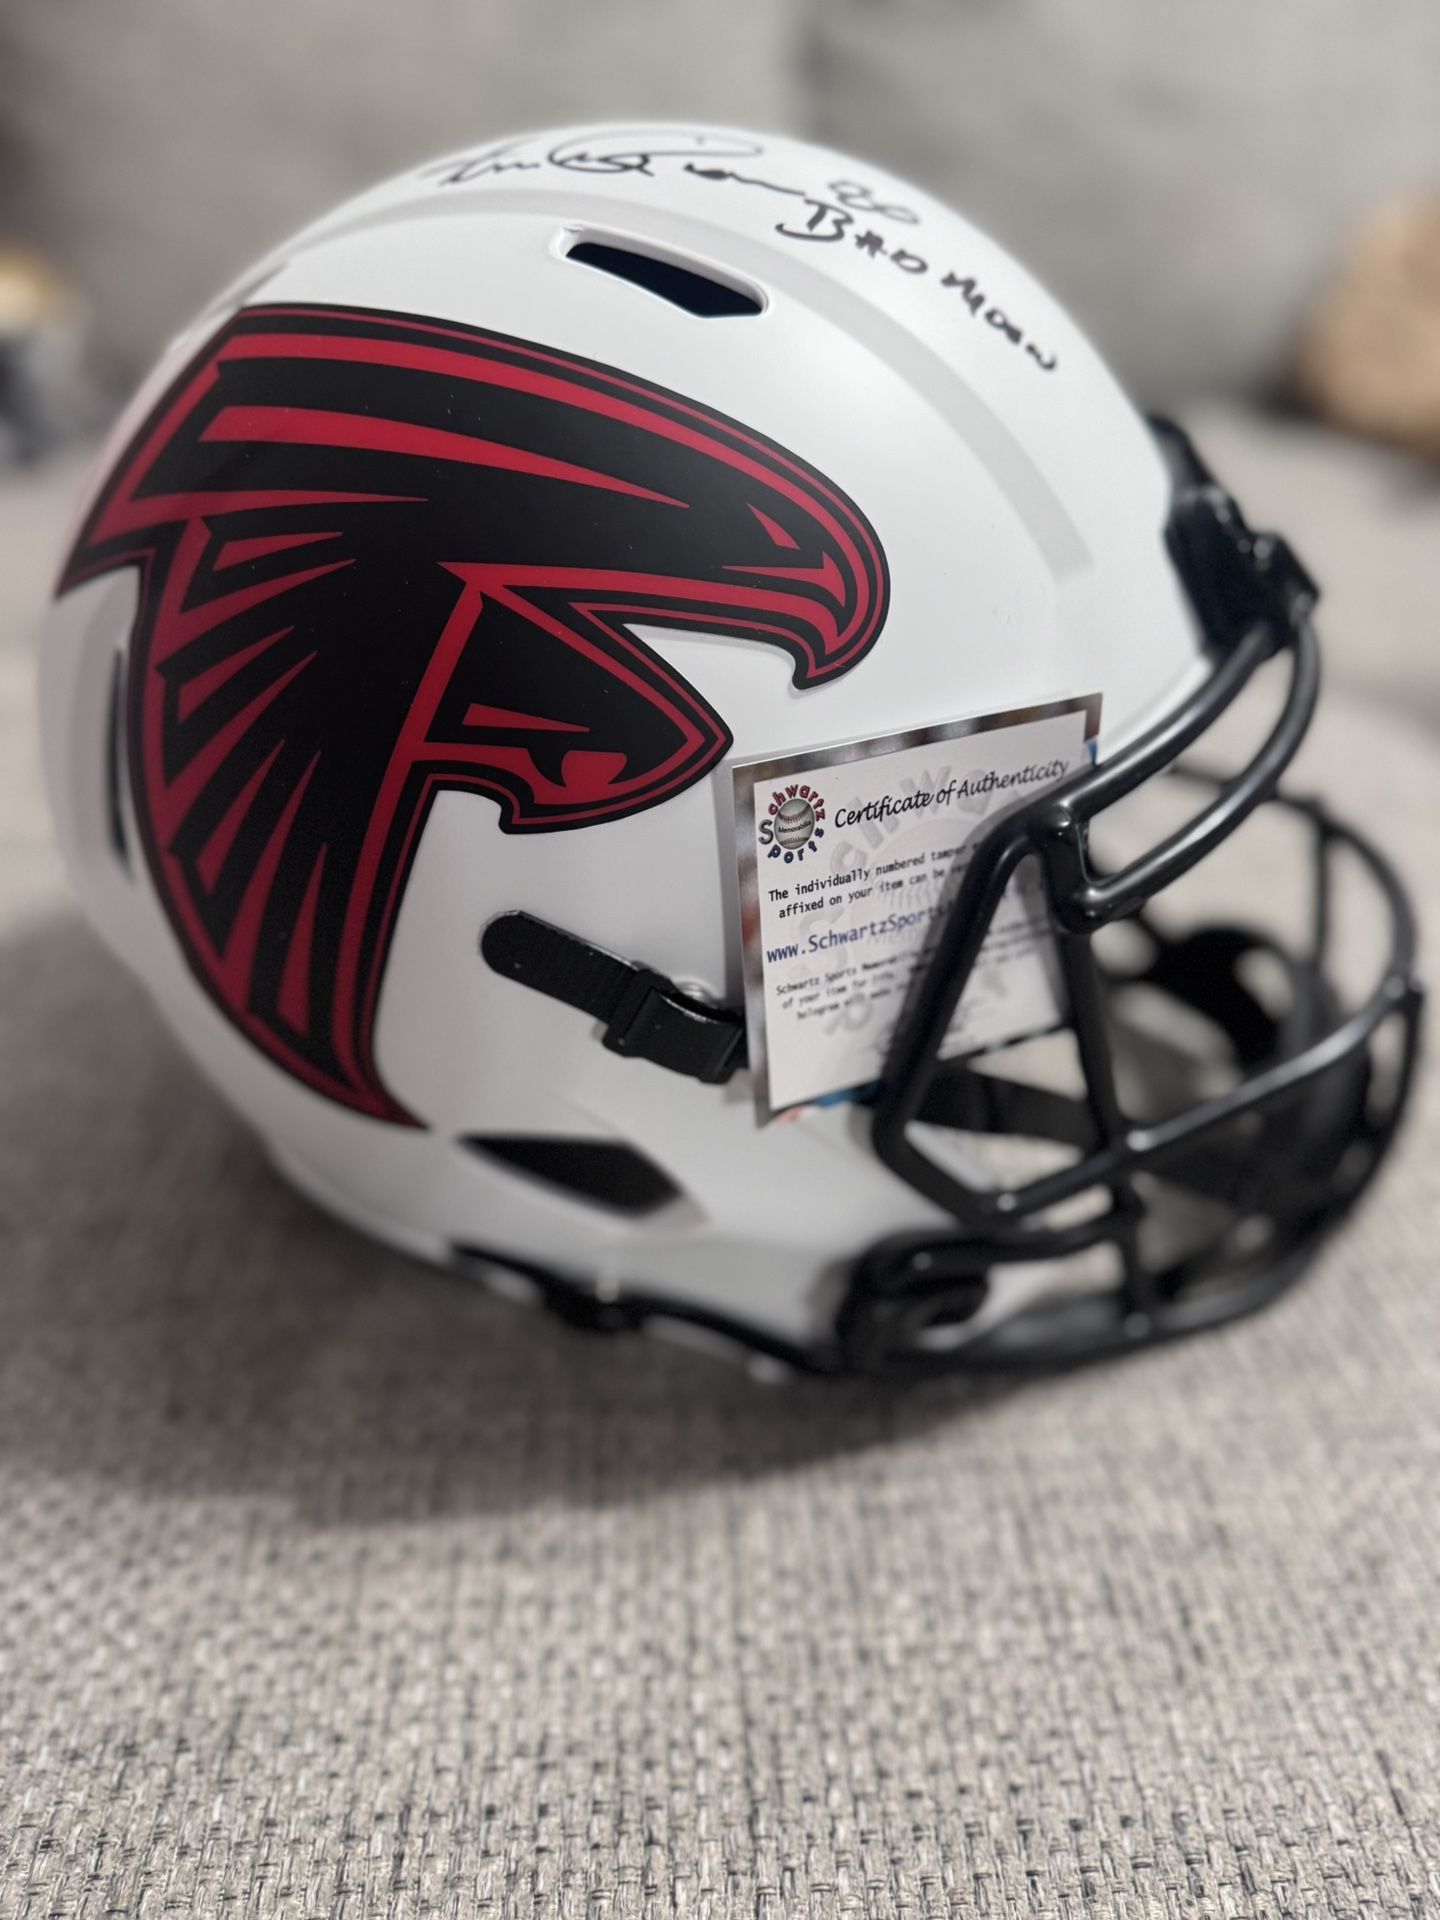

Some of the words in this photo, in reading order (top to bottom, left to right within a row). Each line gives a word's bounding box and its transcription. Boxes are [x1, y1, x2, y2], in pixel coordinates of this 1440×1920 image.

[834, 790, 936, 828] Certificate
[936, 779, 958, 807] of
[957, 758, 1070, 801] Authenticity
[768, 890, 789, 903] The
[795, 868, 871, 896] individually
[875, 851, 926, 877] numbered
[779, 895, 824, 919] affixed
[829, 895, 843, 906] on
[848, 888, 873, 904] your
[879, 878, 904, 893] item
[909, 873, 927, 886] can
[932, 866, 945, 879] be
[775, 976, 820, 996] Schwartz
[782, 996, 794, 1010] of
